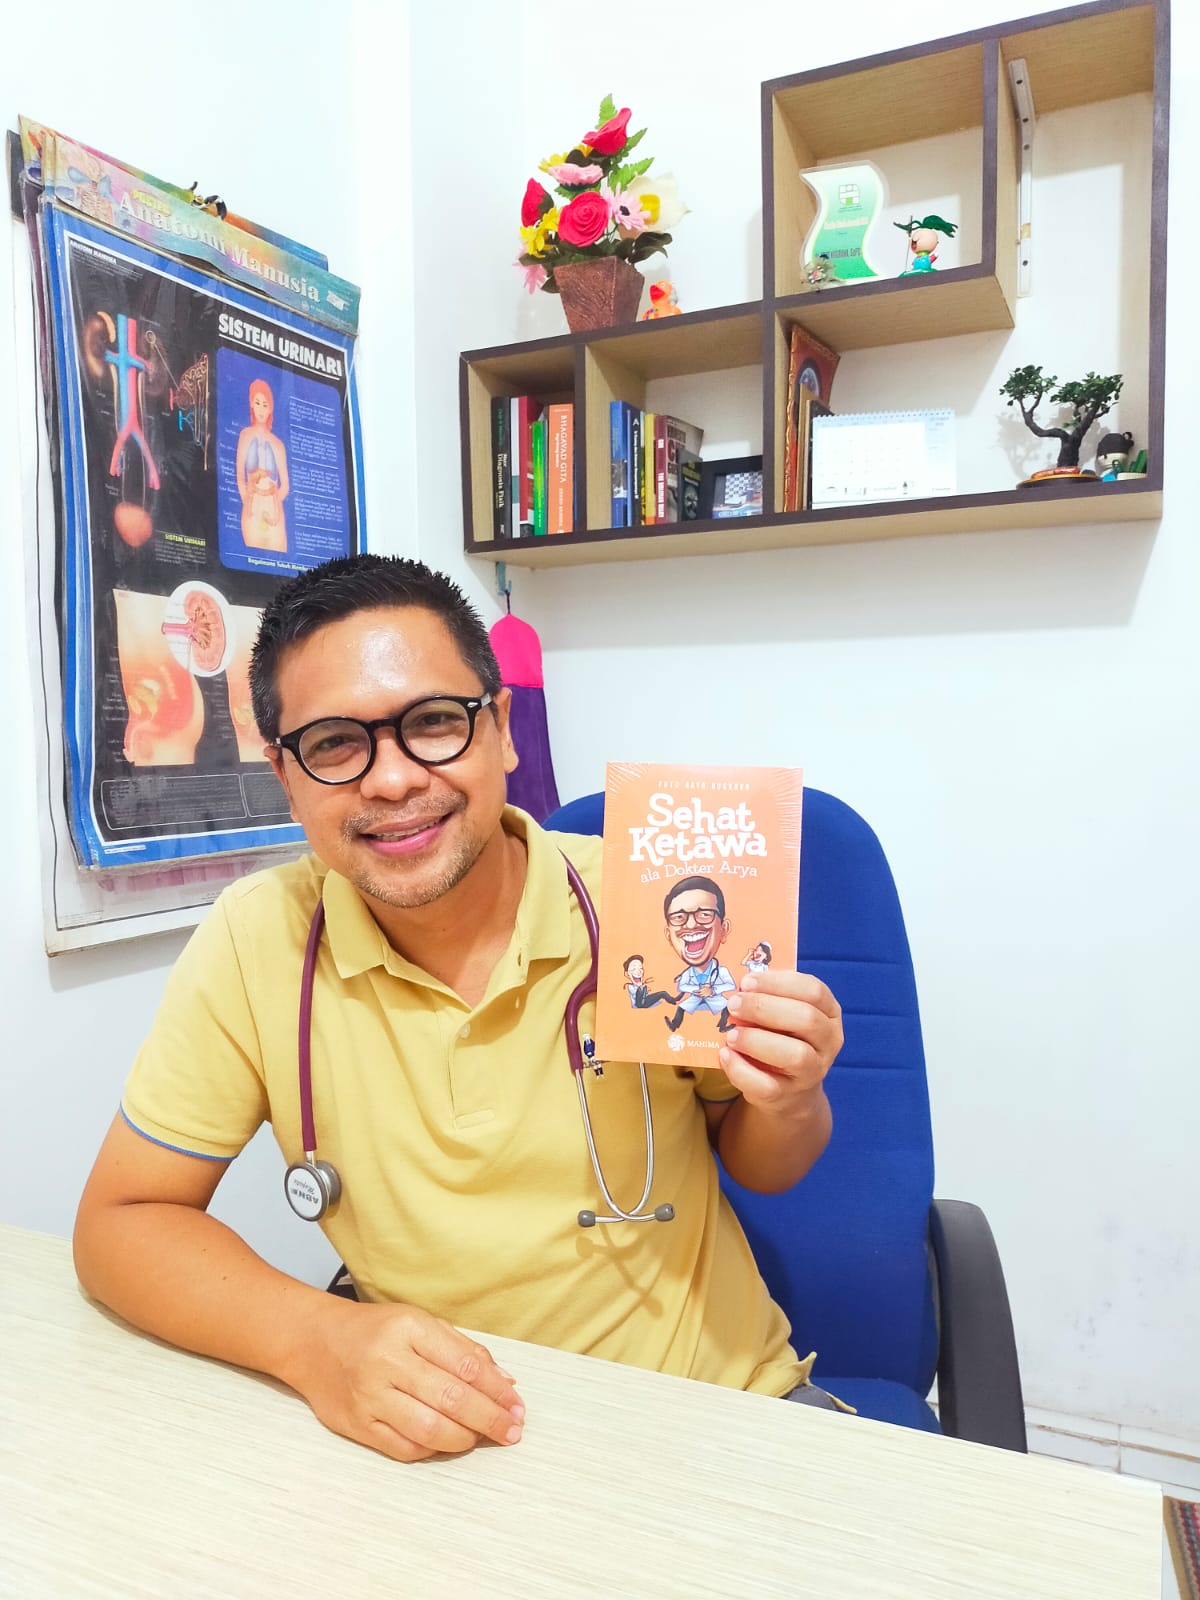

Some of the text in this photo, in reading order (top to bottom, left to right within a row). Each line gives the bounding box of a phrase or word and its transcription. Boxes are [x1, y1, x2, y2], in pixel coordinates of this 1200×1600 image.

[119, 191, 320, 303] Anatomi Manusia
[218, 313, 275, 352] SISTEM
[278, 337, 343, 377] URINARI
[560, 415, 568, 460] BHAGAVAD
[559, 462, 567, 483] GITA
[647, 793, 756, 835] Sehat
[628, 827, 768, 867] Ketawa
[640, 860, 758, 883] ala Dokter Arya
[687, 1039, 720, 1049] MAHIMA
